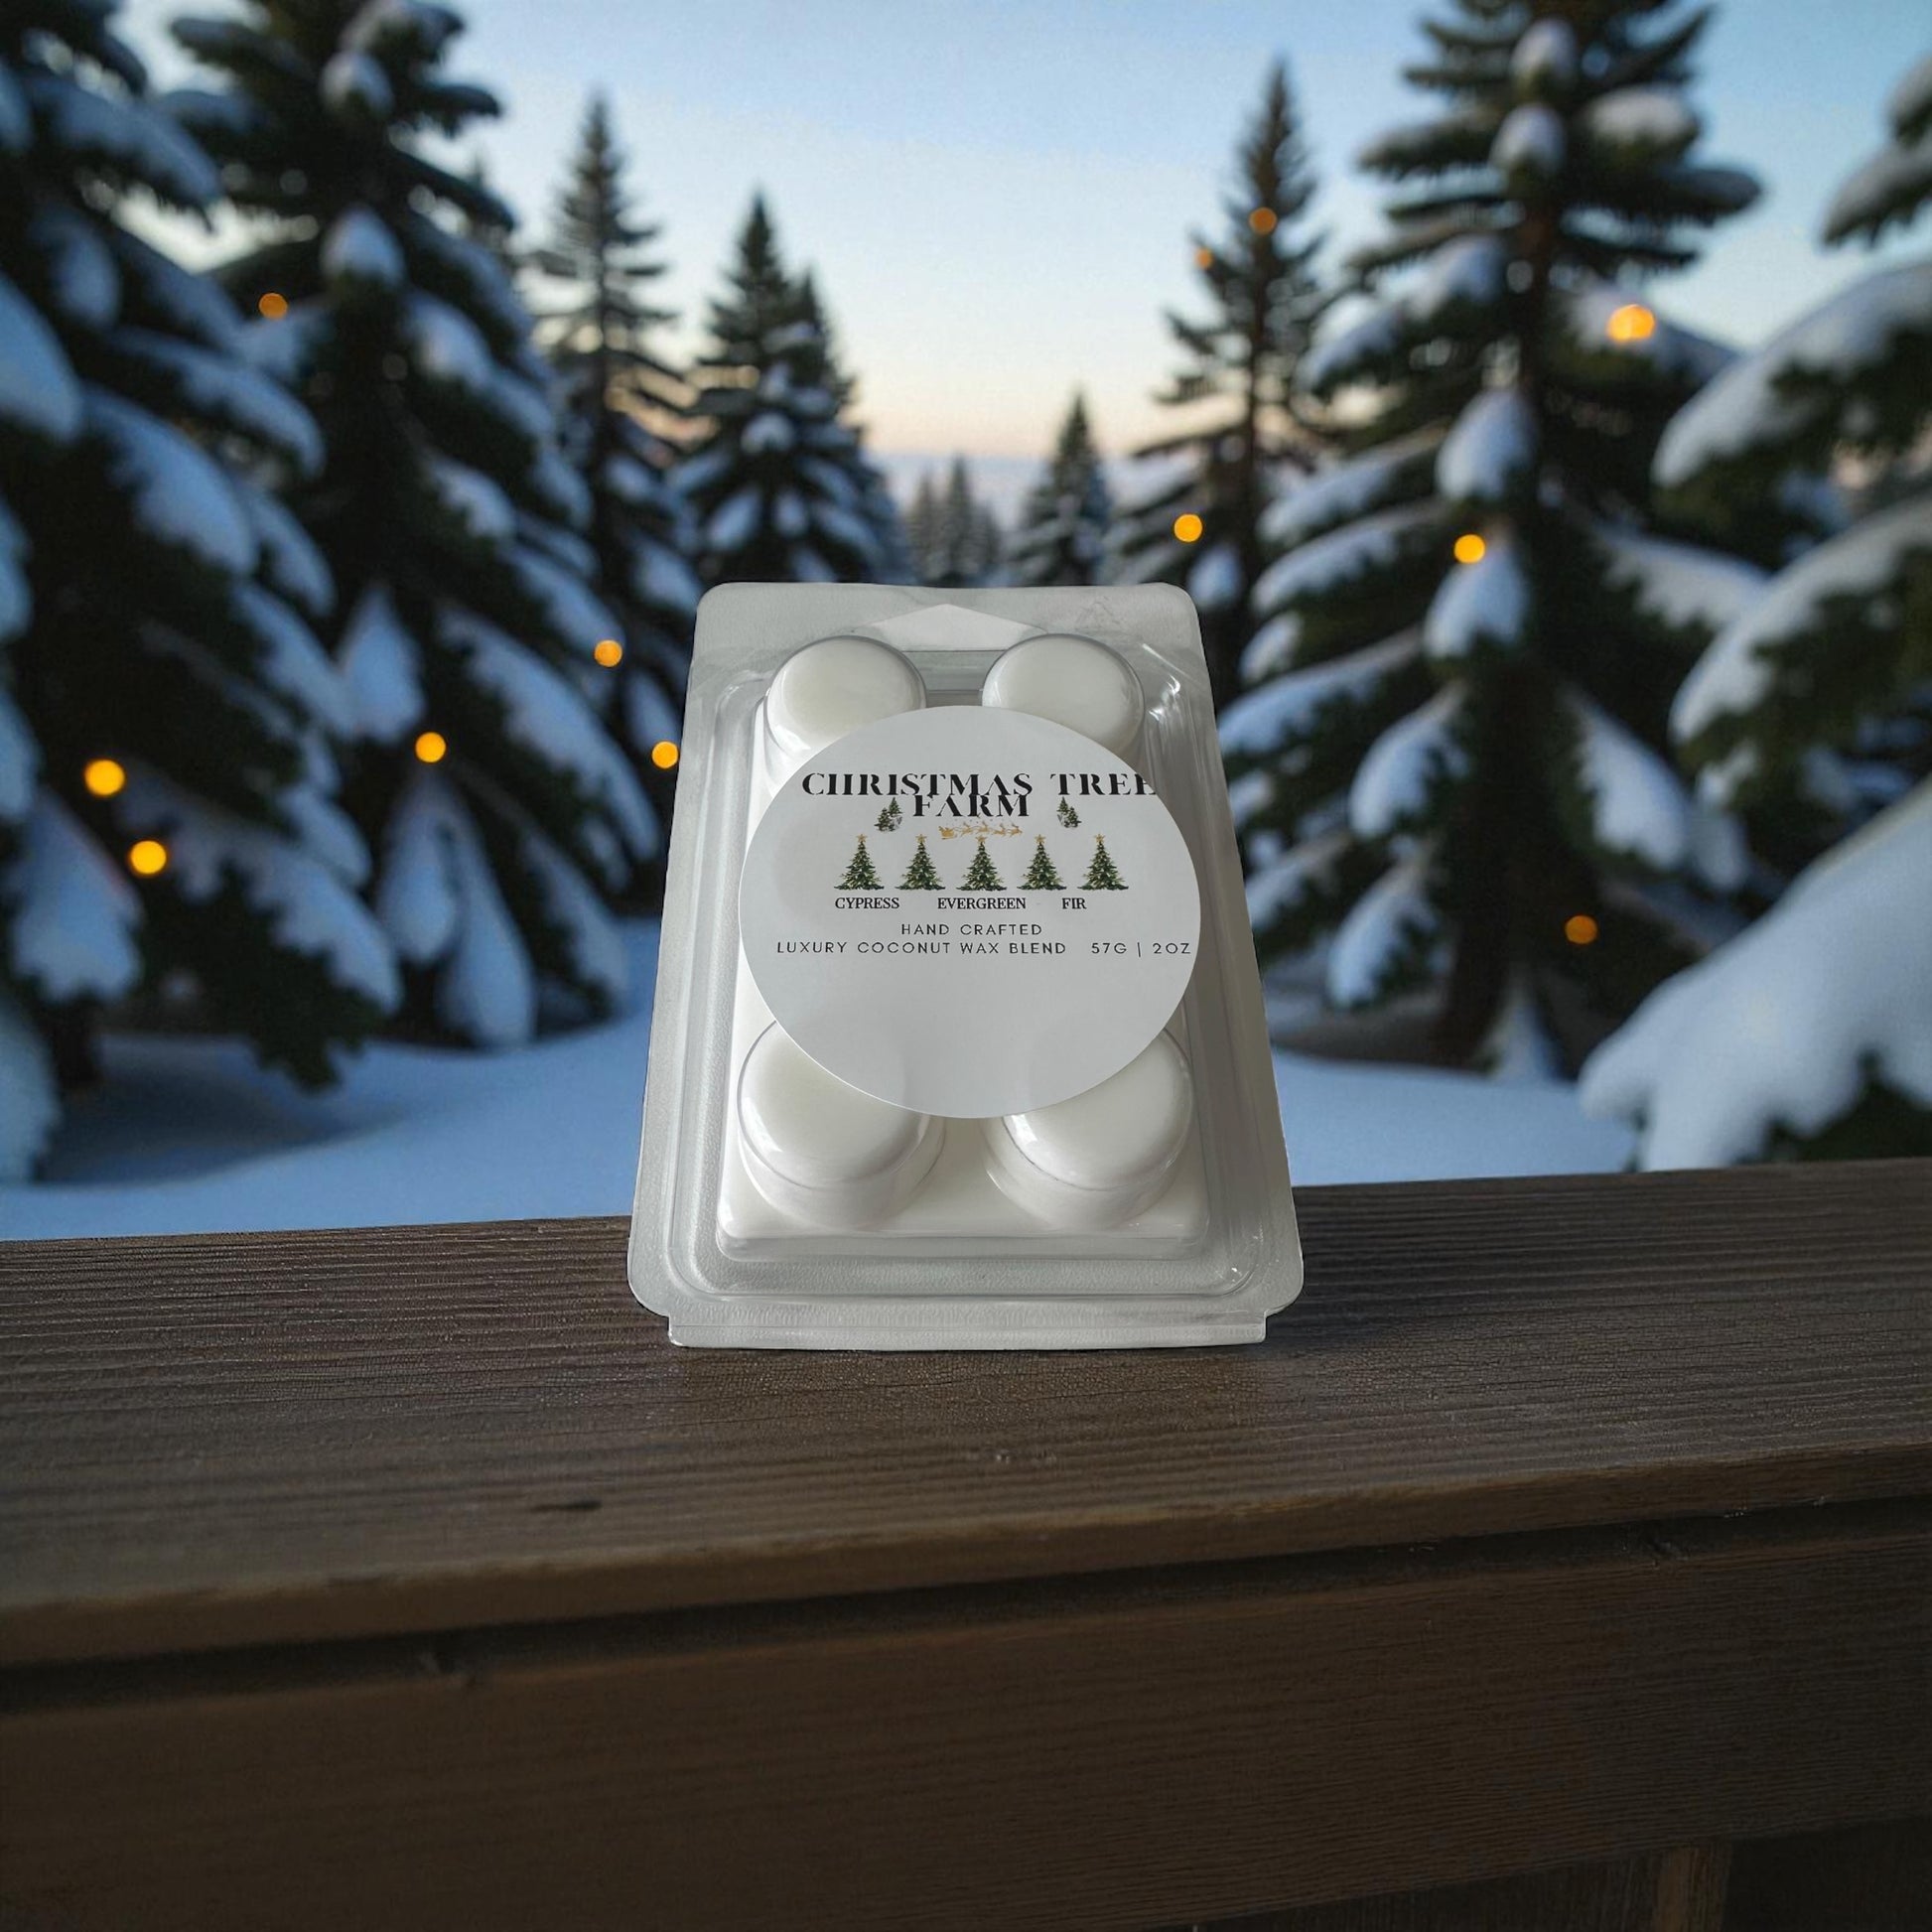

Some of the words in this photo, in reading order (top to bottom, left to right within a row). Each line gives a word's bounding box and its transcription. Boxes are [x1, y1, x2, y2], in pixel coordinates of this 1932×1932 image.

[802, 772, 1034, 795] CHRISTMAS
[911, 794, 1030, 817] FARM
[834, 897, 900, 909] CYPRESS
[937, 897, 1027, 909] EVERGREEN
[1061, 897, 1087, 909] FIR
[900, 923, 950, 936] HAND
[960, 923, 1042, 936] CRAFTED
[776, 941, 848, 954] LUXURY
[857, 941, 951, 954] COCONUT
[959, 942, 1000, 955] WAX
[1009, 942, 1066, 955] BLEND
[1091, 942, 1127, 955] 57G
[1152, 942, 1191, 955] 2OZ
